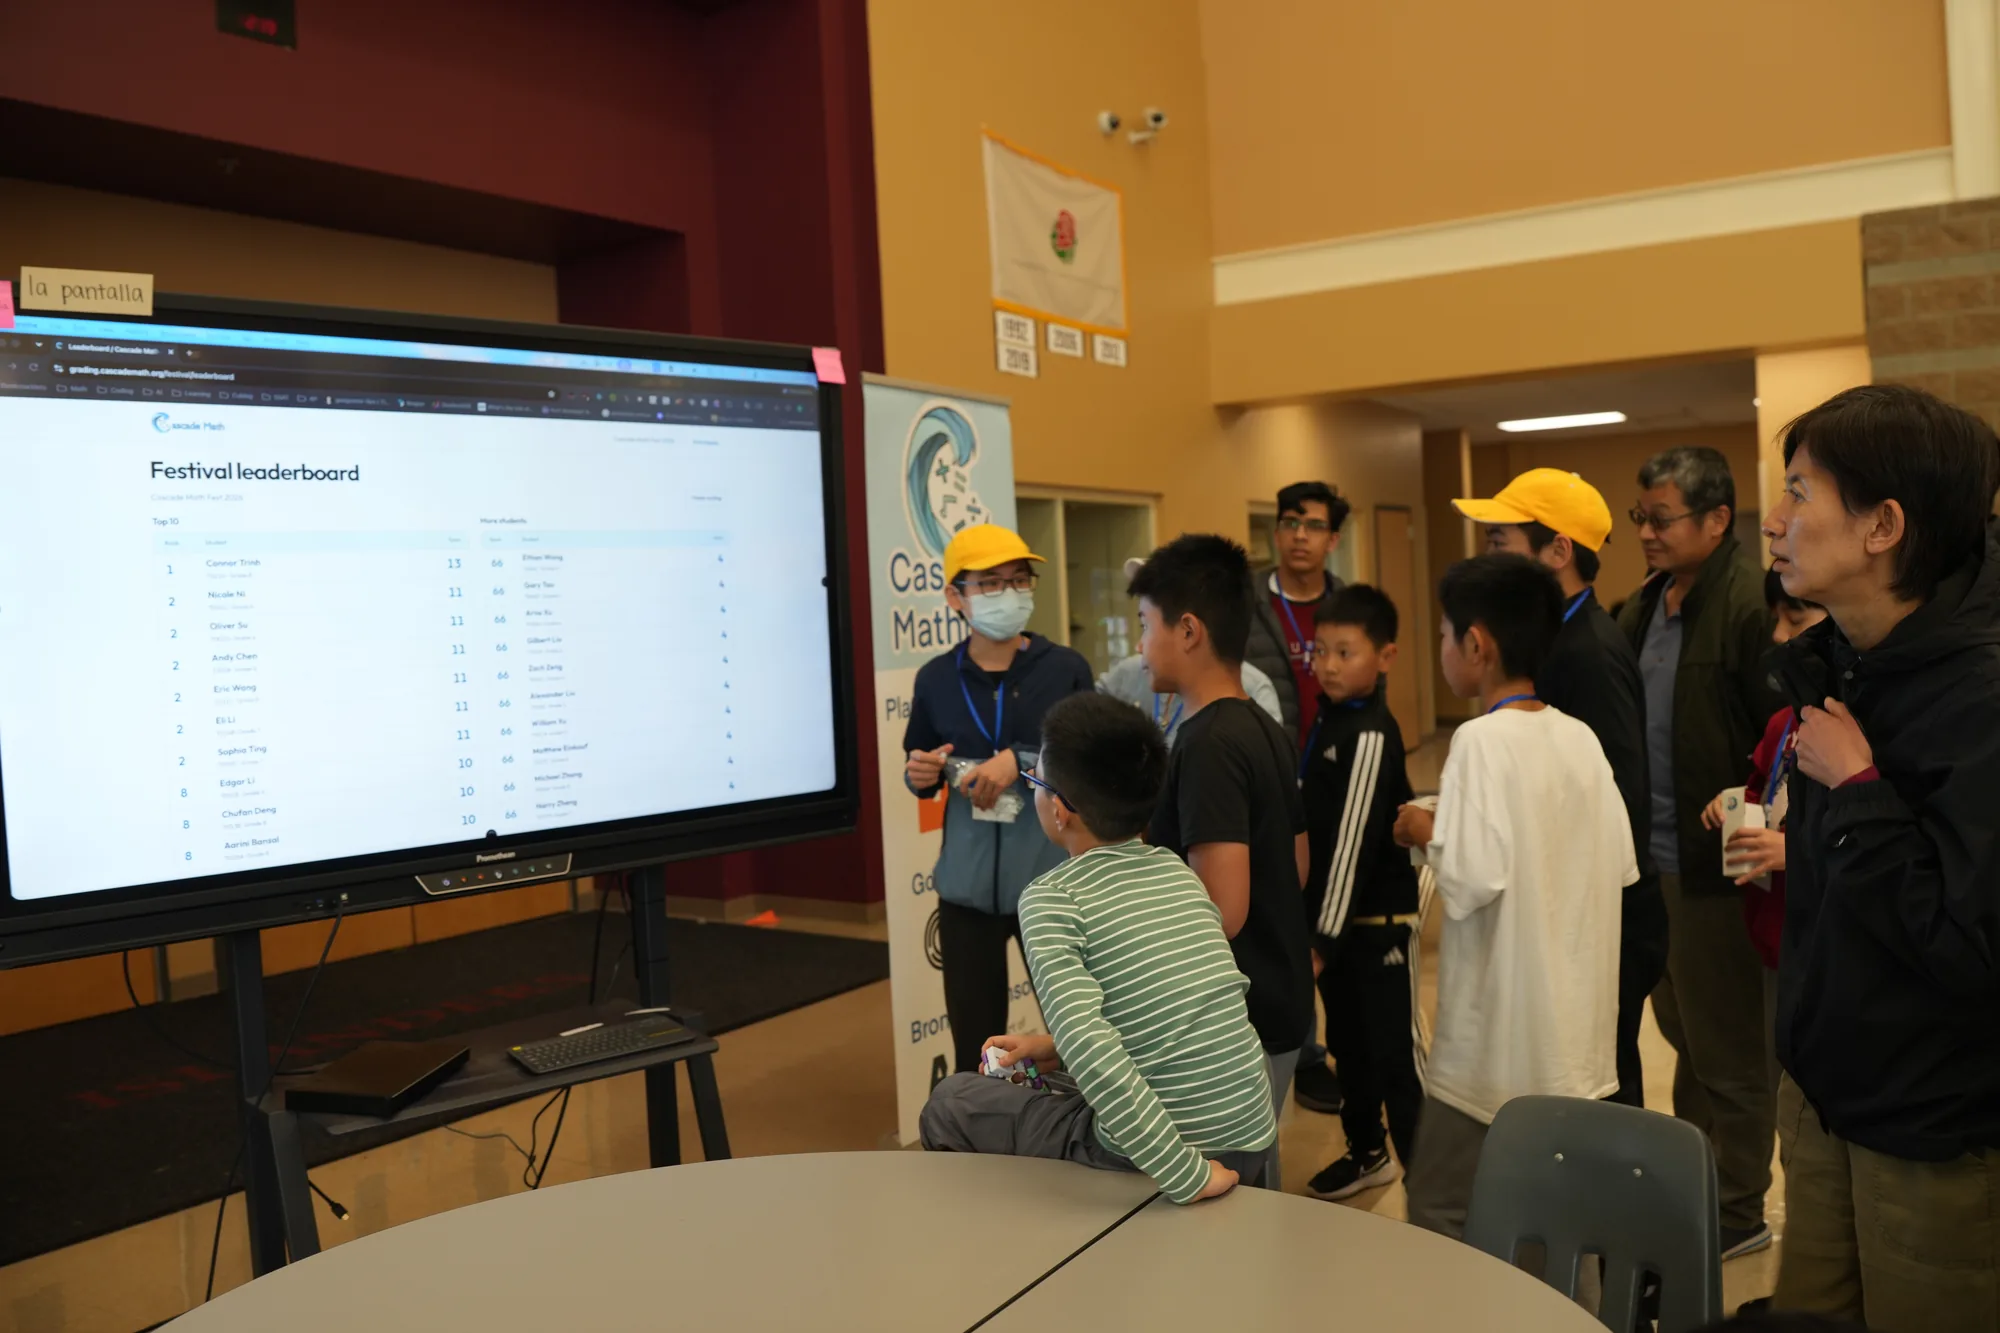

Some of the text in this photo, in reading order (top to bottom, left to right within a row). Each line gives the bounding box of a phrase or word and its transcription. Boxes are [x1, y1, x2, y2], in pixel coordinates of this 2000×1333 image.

[28, 275, 144, 305] la pantalla
[68, 342, 110, 354] Leaderboard
[115, 346, 142, 355] Cascade
[203, 421, 227, 432] Math
[151, 462, 359, 481] Festival leaderboard
[153, 518, 168, 526] Top
[205, 559, 238, 568] Connor
[447, 558, 462, 569] 13
[490, 558, 504, 568] 66
[167, 564, 173, 575] 1
[890, 552, 944, 592] Cas
[207, 590, 246, 599] Nicole Ni
[449, 587, 463, 598] 11
[492, 587, 505, 596] 66
[168, 596, 176, 607] 2
[450, 615, 465, 627] 11
[493, 615, 507, 624] 66
[209, 621, 249, 631] Oliver Su
[170, 628, 177, 639] 2
[452, 643, 466, 655] 11
[495, 643, 508, 652] 66
[211, 652, 258, 662] Andy Chen
[172, 660, 180, 671] 2
[453, 672, 467, 684] 11
[496, 670, 510, 681] 66
[213, 685, 230, 694] Eric
[174, 692, 181, 703] 2
[455, 700, 469, 713] 11
[498, 699, 512, 709] 66
[886, 696, 913, 721] Pla
[215, 716, 236, 725] Eli Li
[176, 724, 183, 735] 2
[457, 729, 471, 741] 11
[500, 727, 513, 737] 66
[217, 745, 267, 757] Sophia Ting
[178, 756, 186, 766] 2
[458, 757, 473, 769] 10
[501, 755, 515, 764] 66
[219, 777, 256, 788] Edgar Li
[503, 781, 516, 792] 66
[180, 787, 188, 798] 8
[460, 785, 475, 798] 10
[254, 807, 277, 815] Deng
[504, 809, 518, 820] 66
[182, 819, 191, 830] 8
[461, 814, 477, 826] 10
[251, 835, 280, 846] Bansal
[184, 851, 193, 861] 8
[476, 852, 516, 863] Promethean
